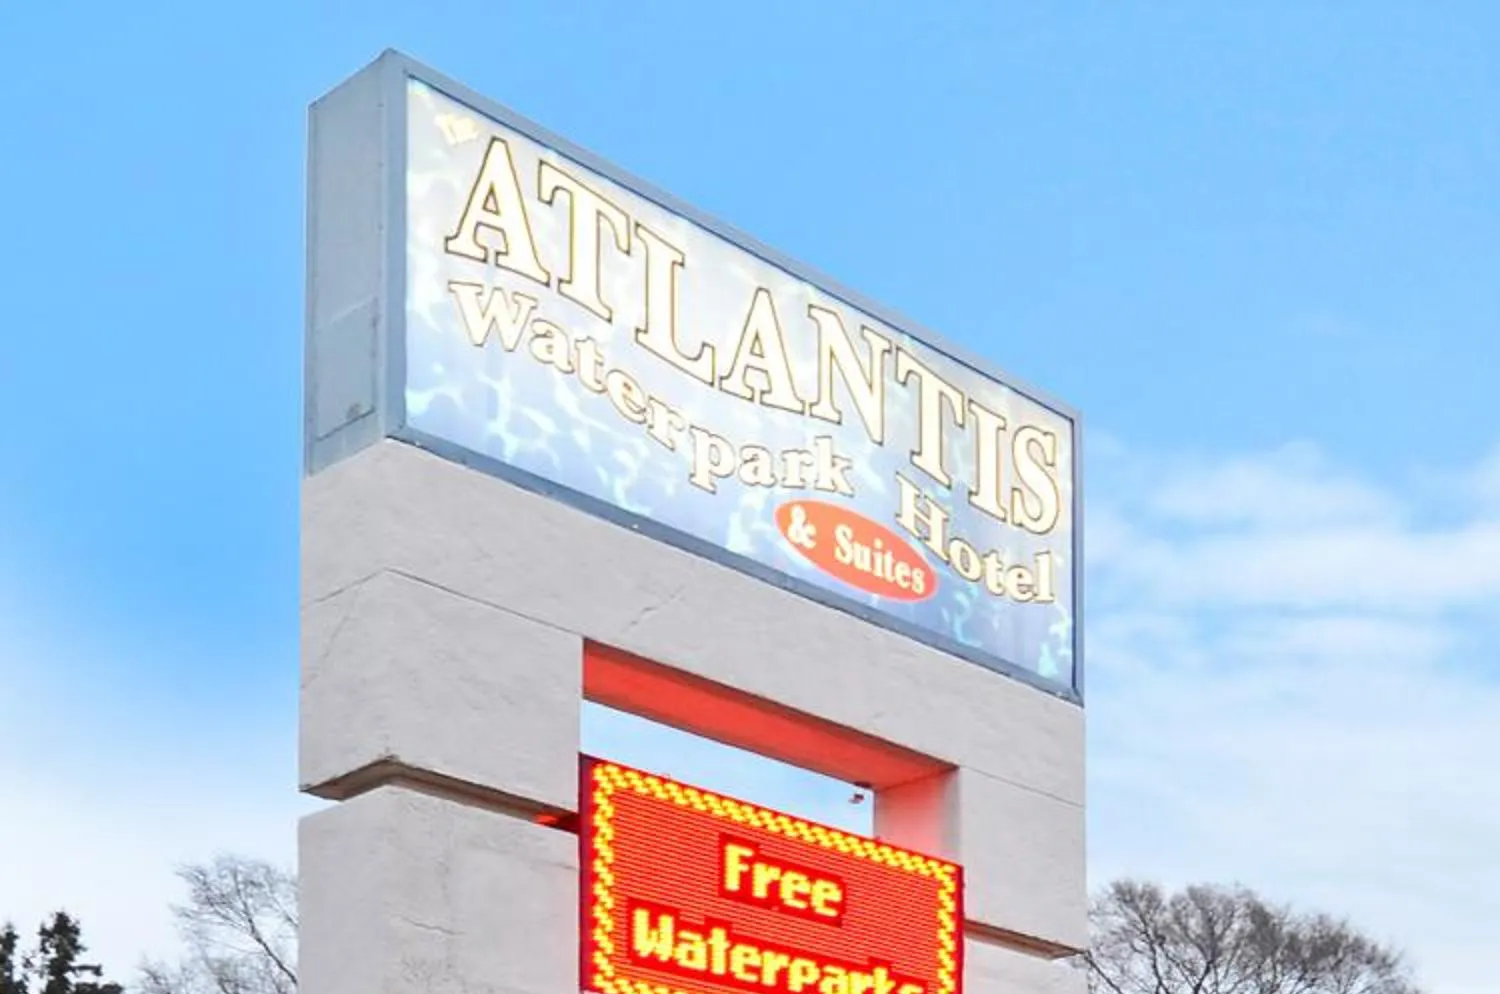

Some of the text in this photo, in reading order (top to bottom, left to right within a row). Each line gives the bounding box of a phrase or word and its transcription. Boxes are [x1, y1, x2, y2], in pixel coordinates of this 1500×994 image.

[445, 136, 1059, 534] ATLANTIS
[448, 280, 1055, 603] Waterpark Hotel
[787, 504, 926, 594] & Suites
[723, 844, 843, 918] Free
